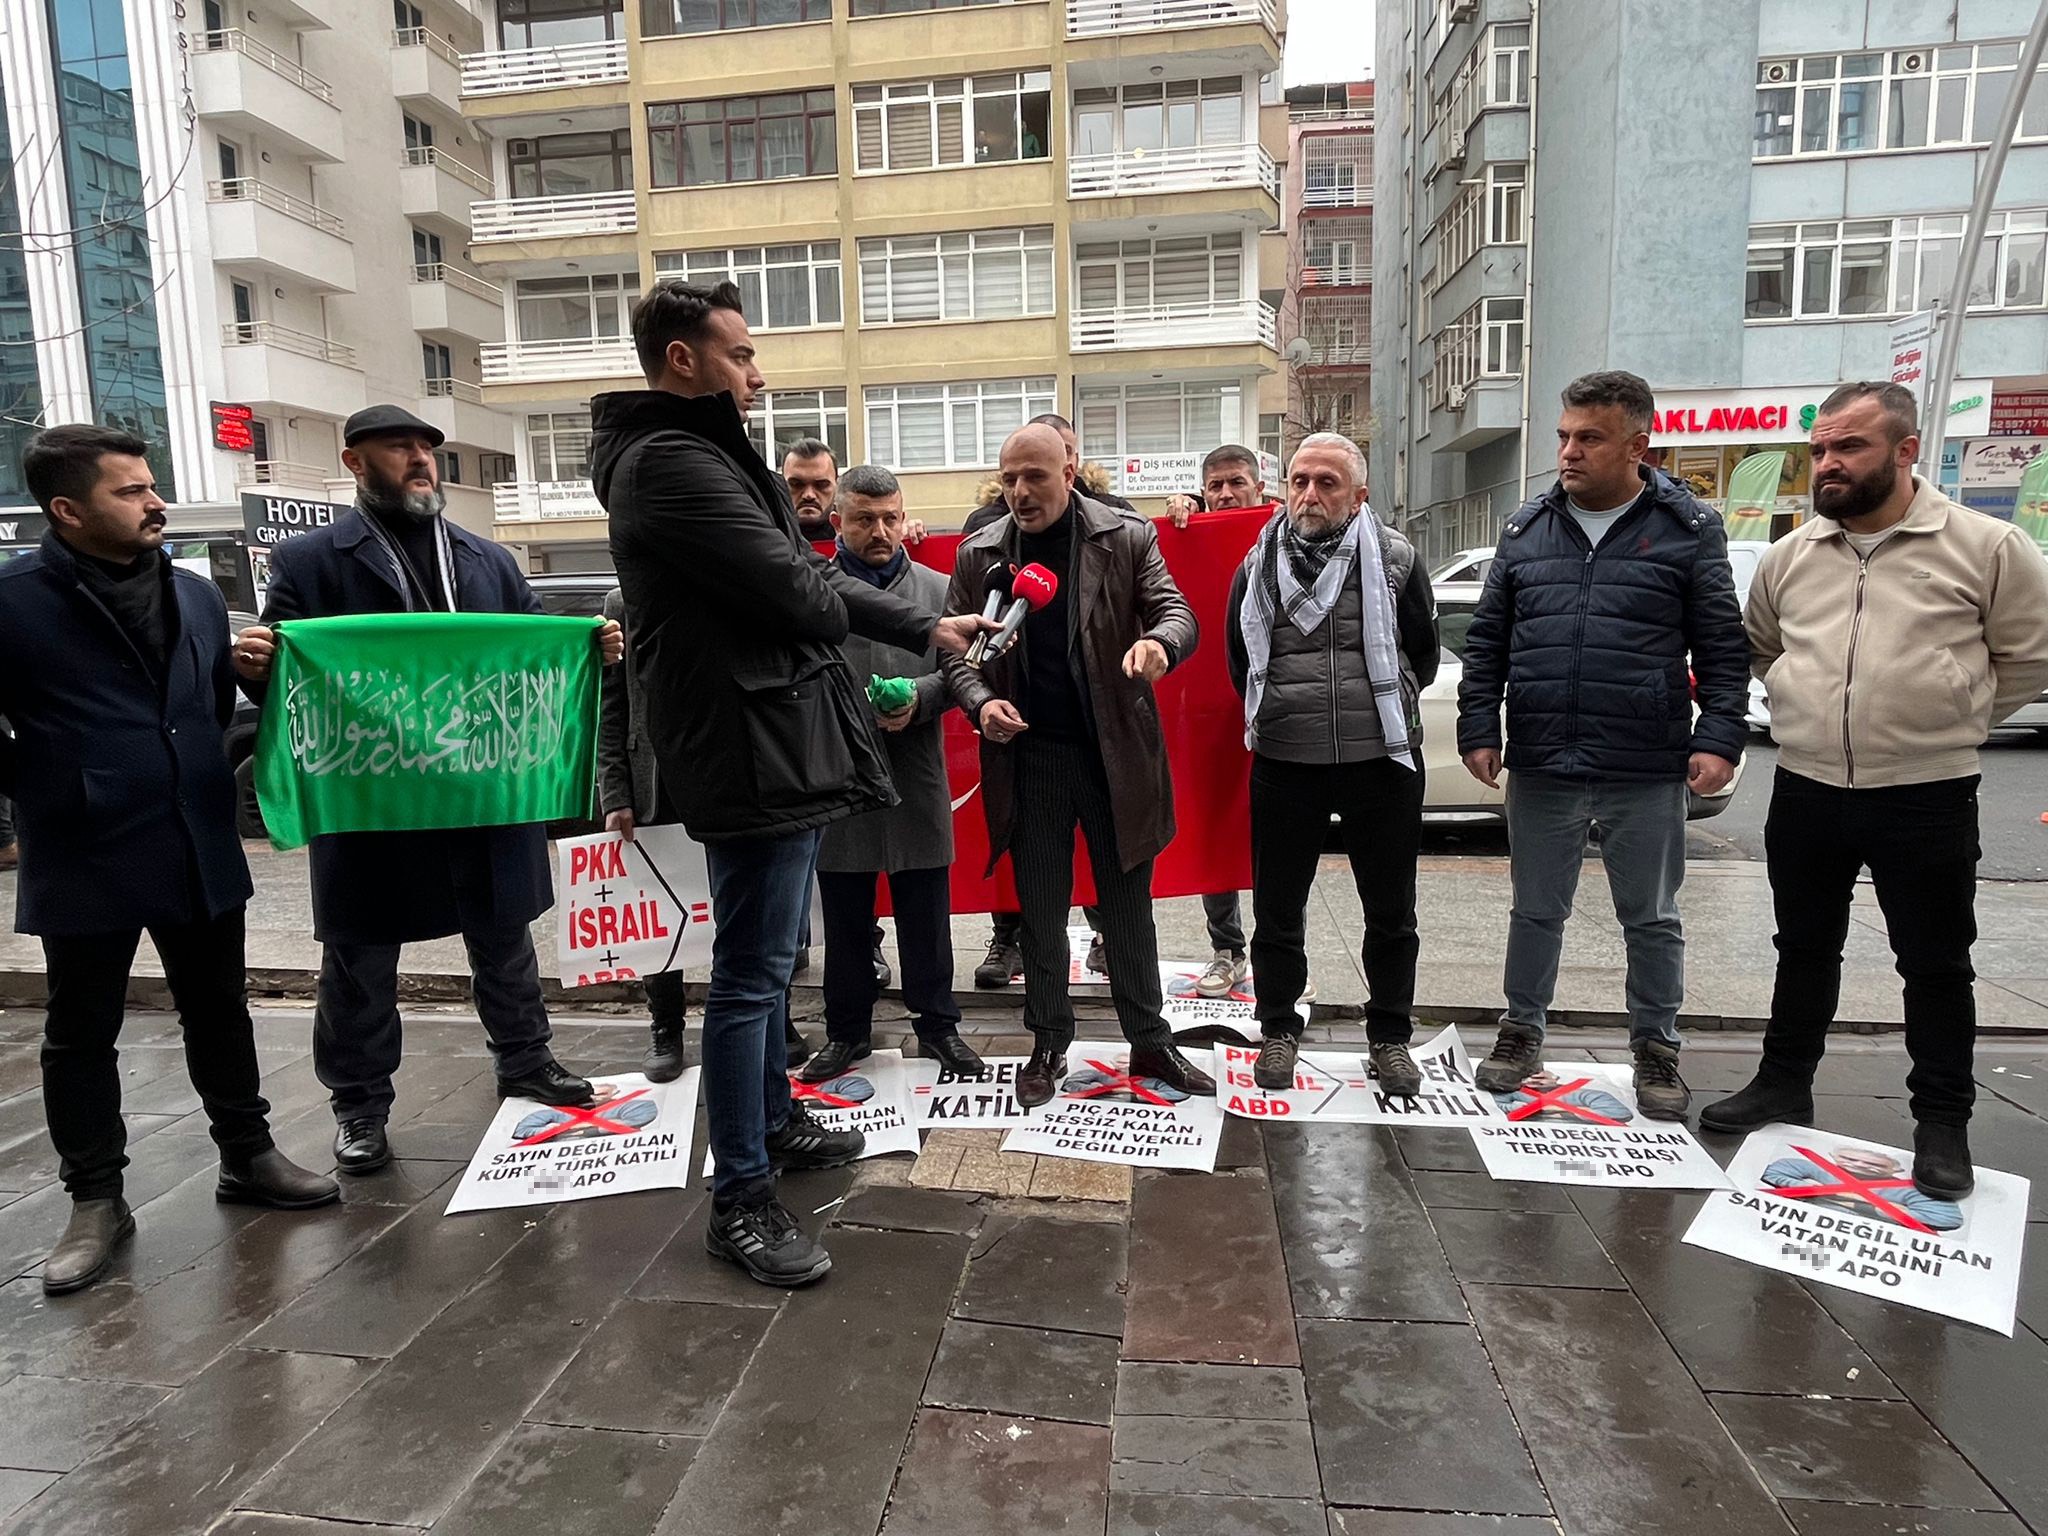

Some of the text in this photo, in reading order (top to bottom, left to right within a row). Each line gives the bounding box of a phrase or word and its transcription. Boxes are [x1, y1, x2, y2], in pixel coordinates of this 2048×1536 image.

[1652, 405, 1788, 433] AKLAVACI
[1143, 457, 1196, 469] DİŞ HEKİMİ
[571, 839, 627, 886] PKK
[569, 889, 668, 950] İSRAİL
[1226, 1047, 1260, 1065] PK
[1226, 1066, 1325, 1091] İSİL
[1066, 1101, 1177, 1122] PİÇ APOYA
[1228, 1095, 1291, 1116] ABD
[1373, 1087, 1490, 1117] KATİLİ
[850, 1105, 897, 1121] ULAN
[1044, 1113, 1194, 1134] SESSİZ KALAN
[1133, 1132, 1202, 1147] VEKİLİ
[1553, 1127, 1621, 1143] DEĞİL
[1624, 1132, 1690, 1146] ULAN
[491, 1133, 674, 1166] SAYIN DEĞİL ULAN
[615, 1144, 678, 1166] KATİLİ
[1055, 1138, 1161, 1158] DEĞİLDİR
[1506, 1141, 1684, 1165] TERÖRİST BAŞI
[572, 1171, 617, 1188] APO
[1605, 1163, 1655, 1179] APO
[1728, 1192, 1992, 1270] SAYIN DEĞİL ULAN
[1760, 1218, 1848, 1252] VATAN
[1857, 1243, 1943, 1277] HAİNİ
[1837, 1260, 1902, 1287] APO
